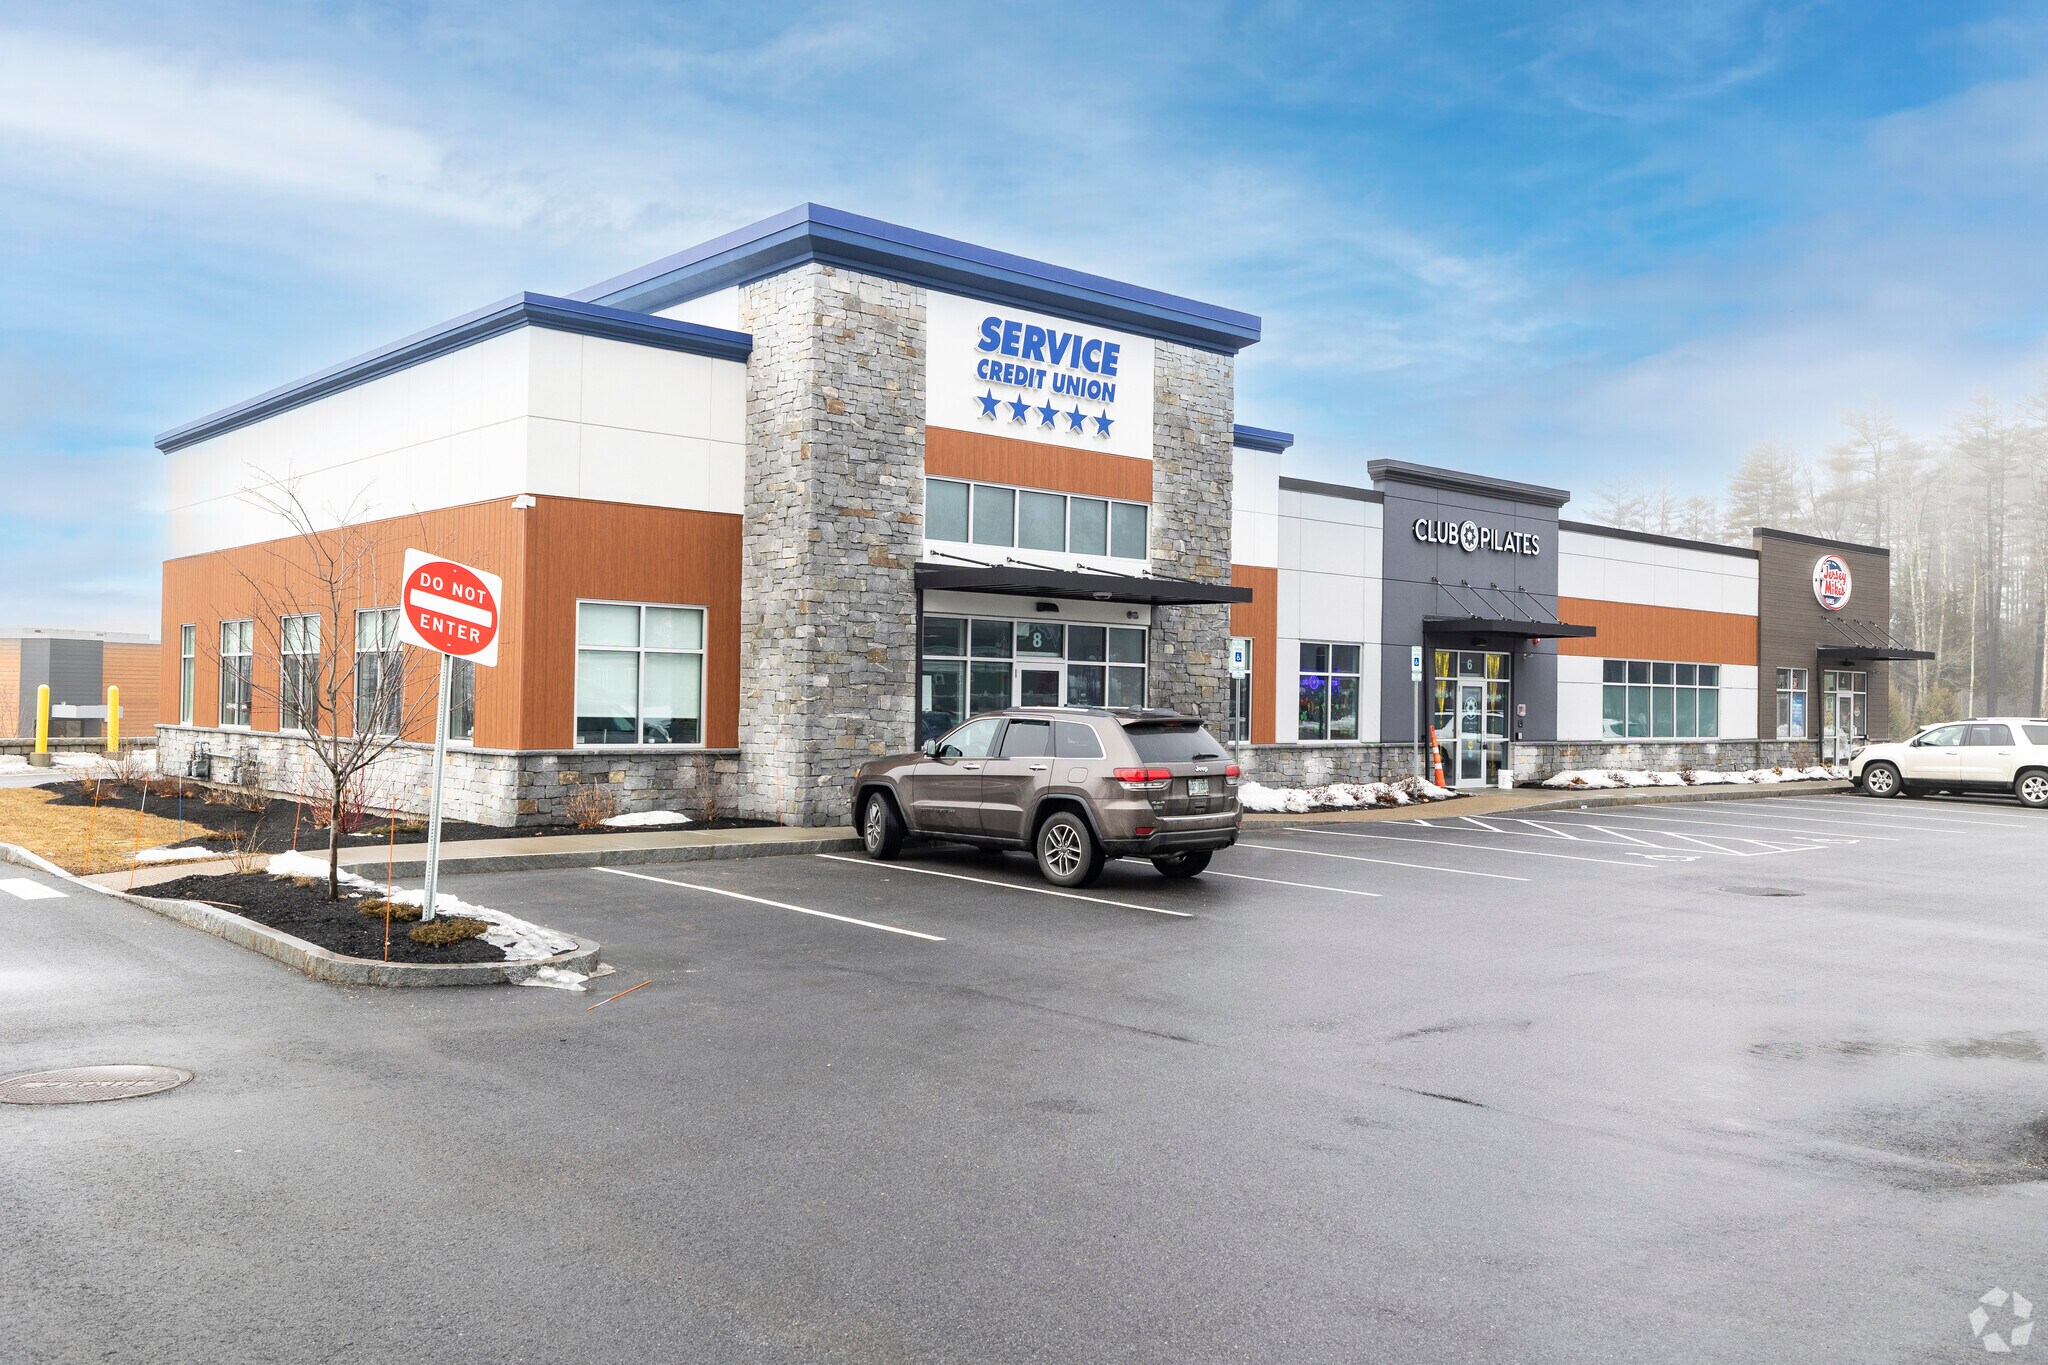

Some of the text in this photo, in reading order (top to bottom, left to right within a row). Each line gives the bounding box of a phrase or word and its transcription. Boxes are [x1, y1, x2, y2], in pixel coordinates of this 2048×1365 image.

[977, 316, 1121, 377] SERVICE
[976, 358, 1116, 403] CREDIT UNION
[1414, 518, 1540, 556] CLUB PILATES
[420, 572, 487, 604] DO NOT
[1823, 565, 1847, 586] Jersey
[420, 613, 481, 644] ENTER
[1032, 632, 1042, 648] 8
[1466, 658, 1473, 670] 6
